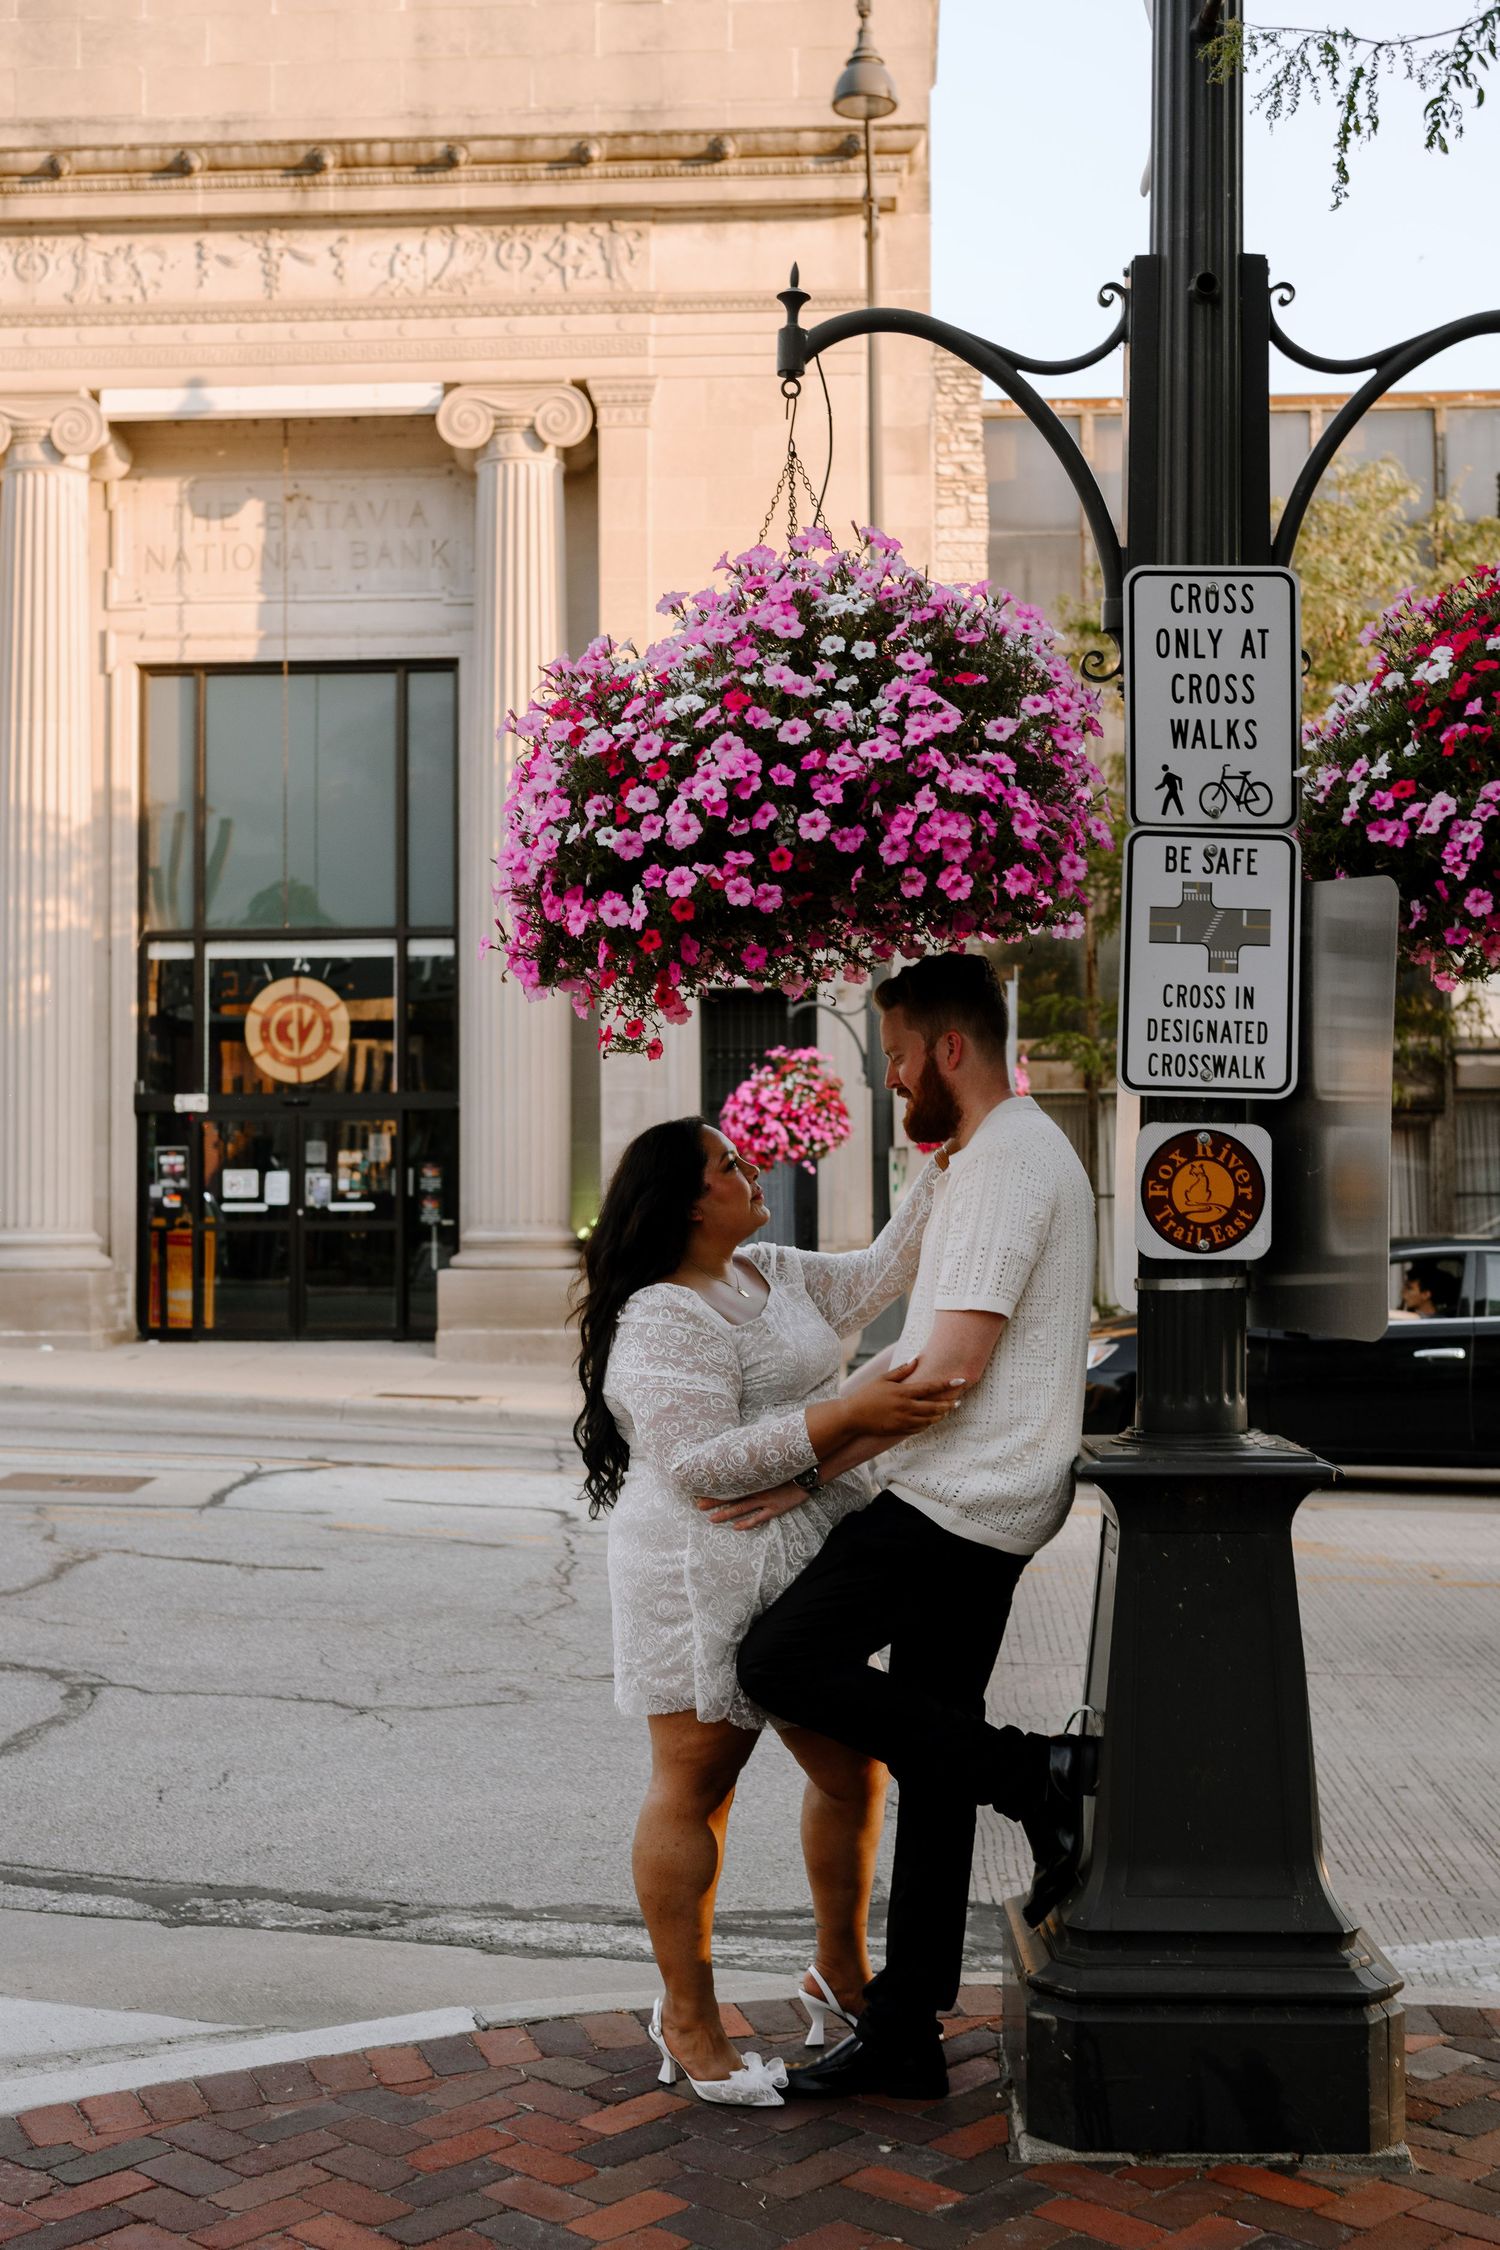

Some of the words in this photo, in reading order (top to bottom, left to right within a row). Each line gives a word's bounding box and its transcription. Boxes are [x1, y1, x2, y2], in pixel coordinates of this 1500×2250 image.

[164, 503, 240, 532] THE
[263, 500, 430, 532] BATAVIA
[143, 542, 333, 574] NATIONAL
[350, 539, 452, 571] BANK
[1170, 583, 1255, 614] CROSS
[1156, 628, 1223, 659] ONLY
[1240, 628, 1270, 659] AT
[1171, 673, 1256, 704] CROSS
[1170, 719, 1258, 750] WALKS
[1165, 845, 1192, 874] BE
[1202, 846, 1258, 876] SAFE
[1163, 983, 1226, 1009] CROSS
[1235, 986, 1255, 1010] IN
[1147, 1018, 1268, 1045] DESIGNATED
[1148, 1053, 1266, 1080] CROSSWALK
[1148, 1149, 1188, 1199] Fox
[1195, 1134, 1253, 1201] River
